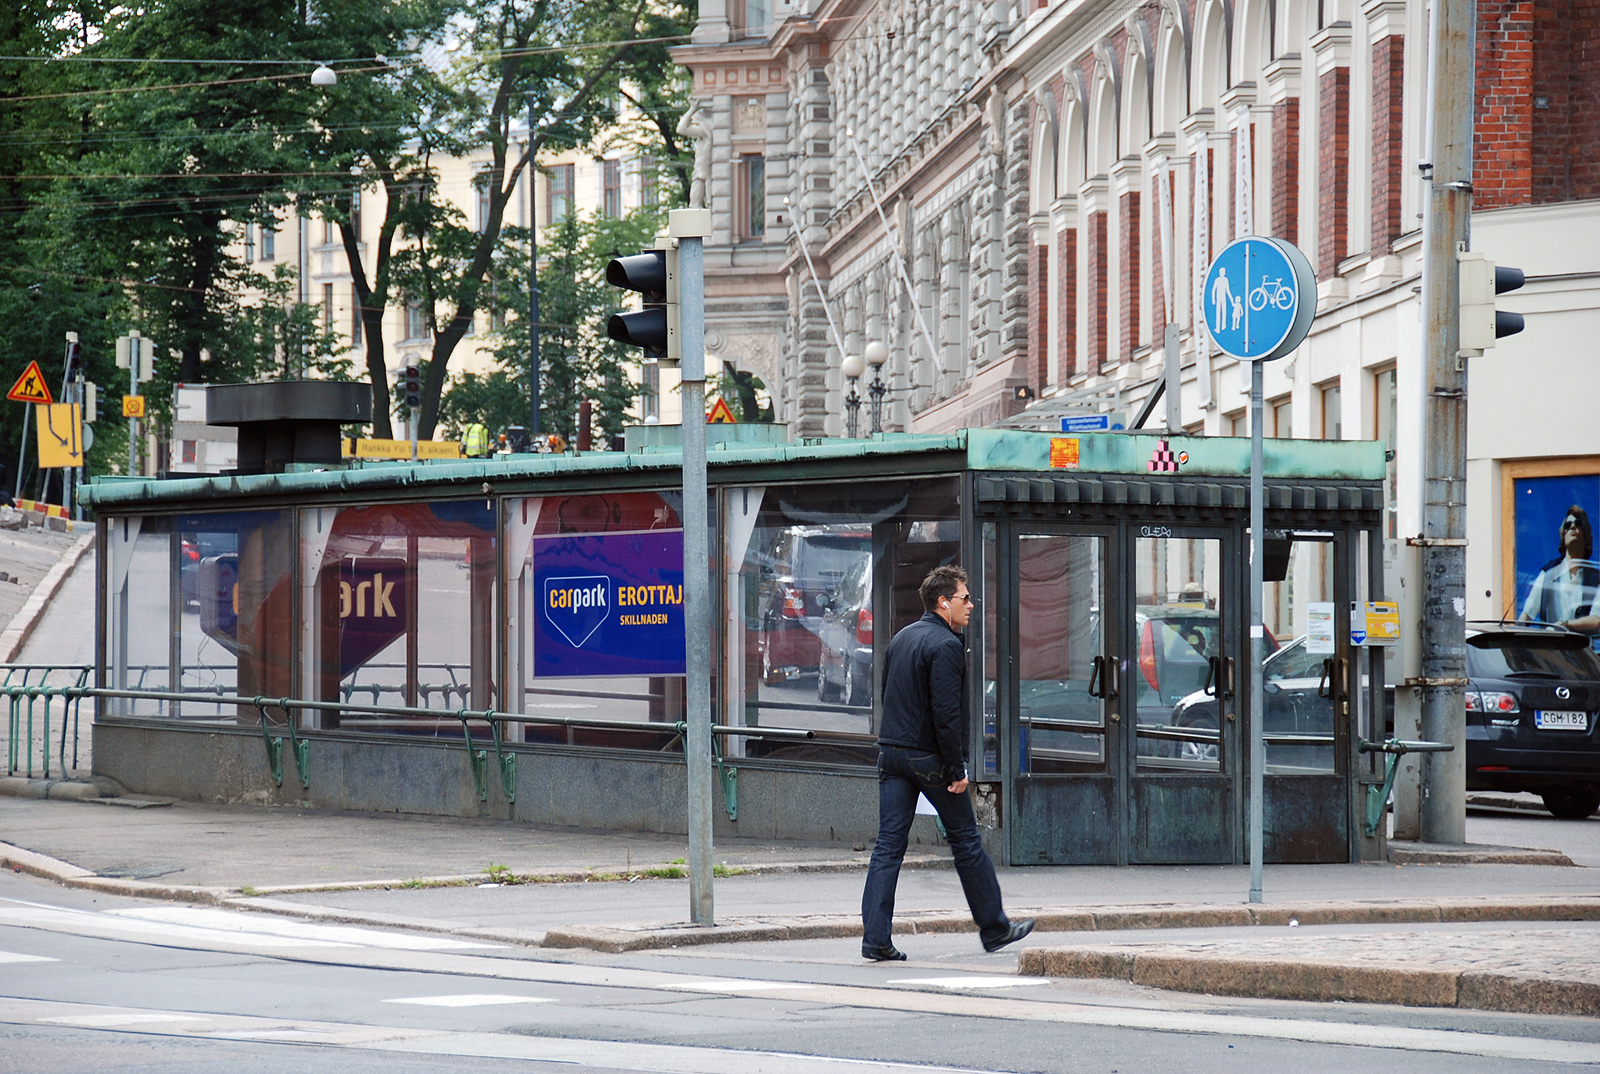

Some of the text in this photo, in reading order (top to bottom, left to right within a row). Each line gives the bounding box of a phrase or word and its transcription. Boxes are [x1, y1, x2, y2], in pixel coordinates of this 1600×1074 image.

[362, 444, 390, 453] Ratikka
[550, 583, 606, 614] carpark
[618, 584, 685, 606] EROTTAJ
[620, 613, 668, 626] SKILLNADEN
[1543, 712, 1585, 725] CGM-182
